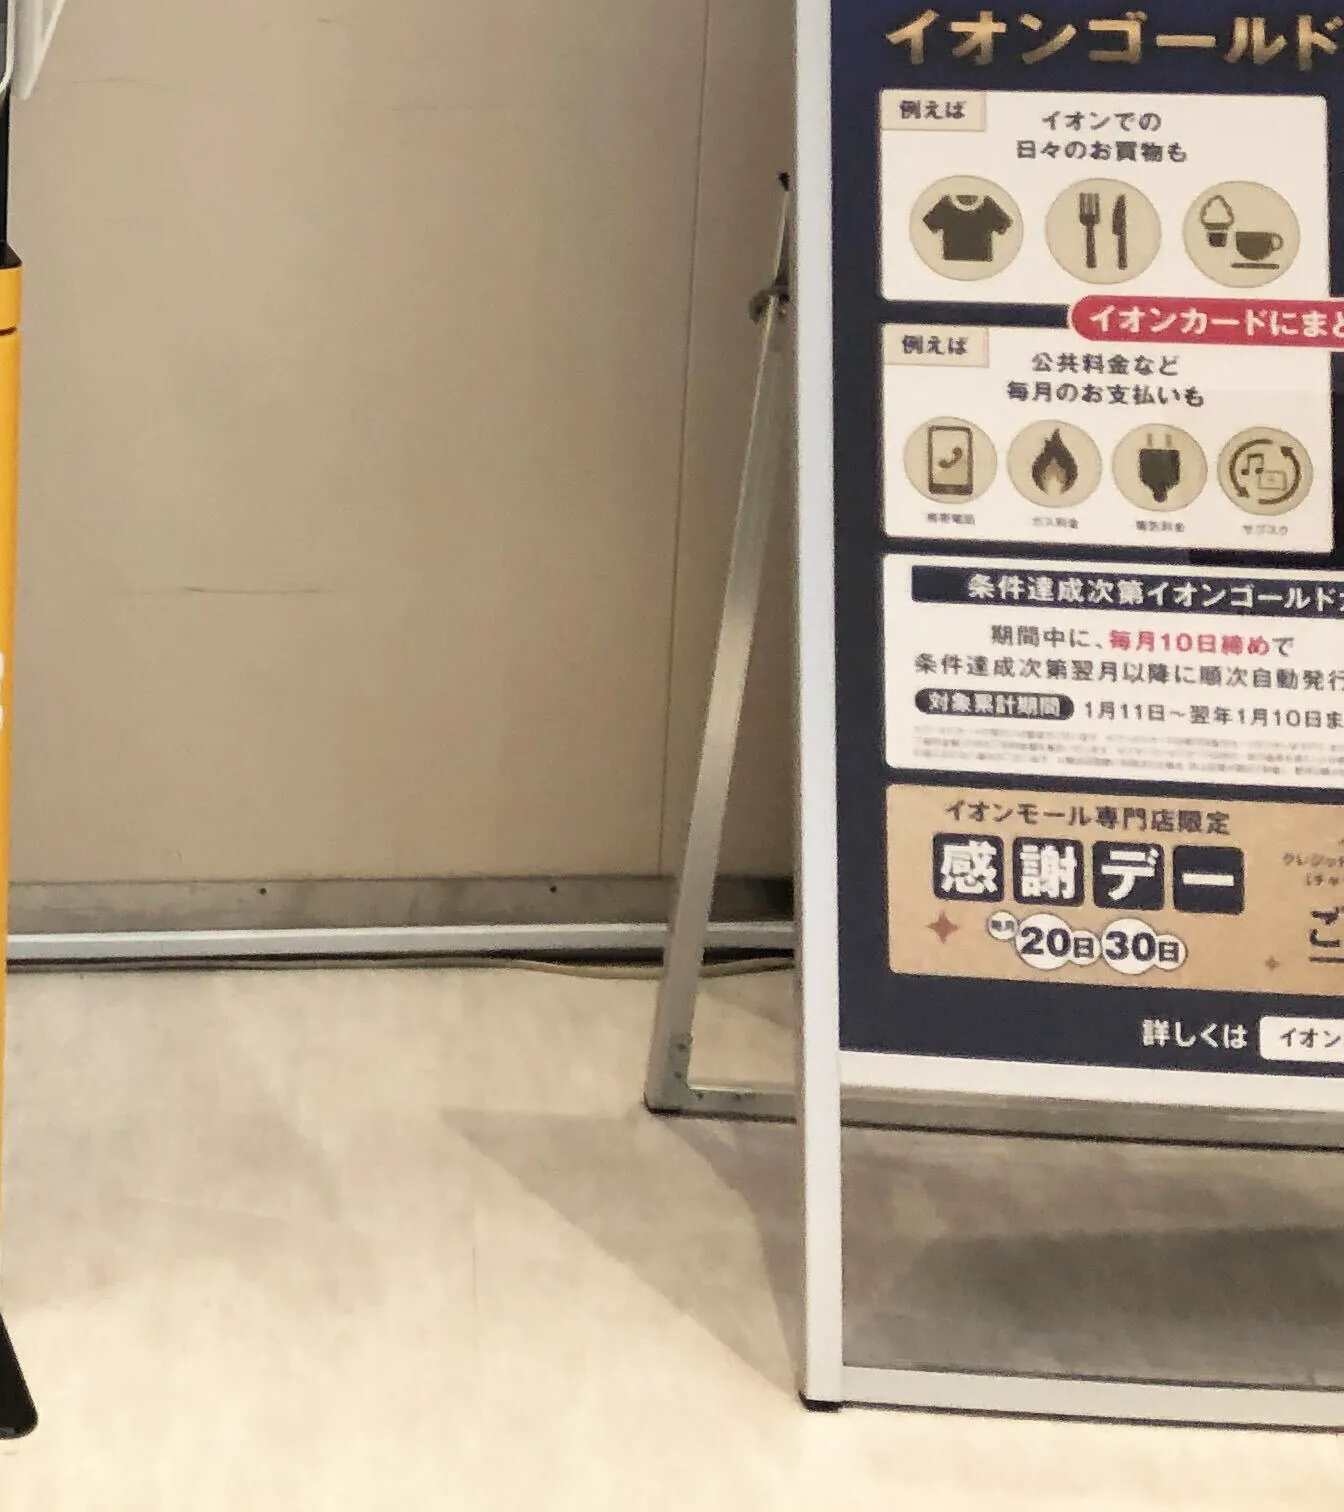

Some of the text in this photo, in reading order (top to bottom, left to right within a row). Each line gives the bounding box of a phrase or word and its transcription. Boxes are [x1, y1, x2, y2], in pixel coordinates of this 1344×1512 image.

[886, 9, 1344, 71] イオンゴールド
[899, 100, 966, 120] 例えば
[1041, 111, 1161, 132] イオンでの
[1016, 139, 1188, 164] 日々のお買物も
[901, 335, 968, 356] 例えば
[1031, 353, 1180, 377] 公共料金など
[1006, 381, 1204, 407] 毎月のお支払いも
[968, 573, 1344, 612] 条件達成次第イオンゴールド
[945, 799, 1231, 835] イオンモール専門店限定
[940, 841, 1235, 902] 感謝デー
[1142, 1019, 1248, 1050] 詳しくは
